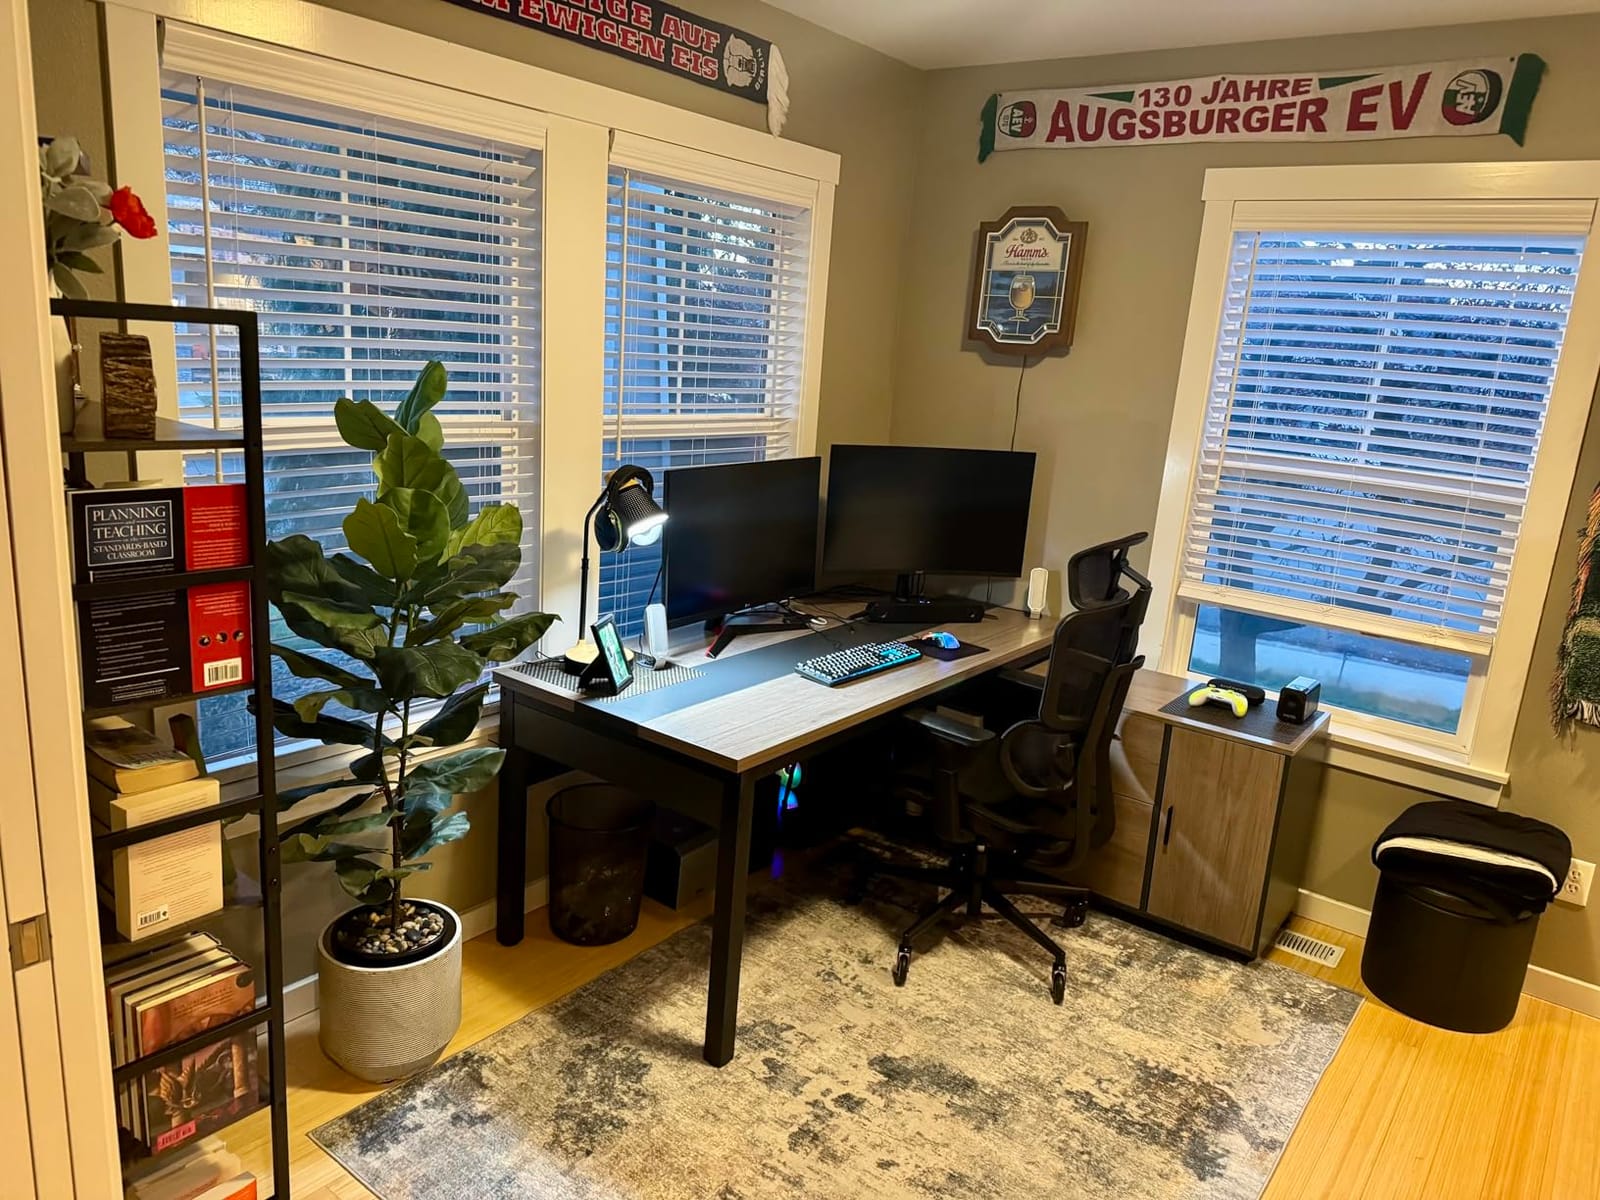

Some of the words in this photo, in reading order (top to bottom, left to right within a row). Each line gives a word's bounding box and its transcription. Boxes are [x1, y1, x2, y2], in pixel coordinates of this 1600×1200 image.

[519, 0, 665, 62] EWIGEN
[672, 44, 719, 81] EIS
[661, 13, 720, 53] AUF
[1138, 85, 1192, 108] 130
[1201, 78, 1313, 105] JAHRE
[1045, 97, 1329, 143] AUGSBURGER
[1346, 71, 1432, 132] EV
[1010, 108, 1024, 132] AEV
[1004, 244, 1049, 258] Hamm's
[93, 505, 166, 521] PLANNING
[93, 523, 166, 539] TEACHING
[93, 540, 168, 553] STANDARDS-BASED
[107, 549, 156, 560] CLASSROOM
